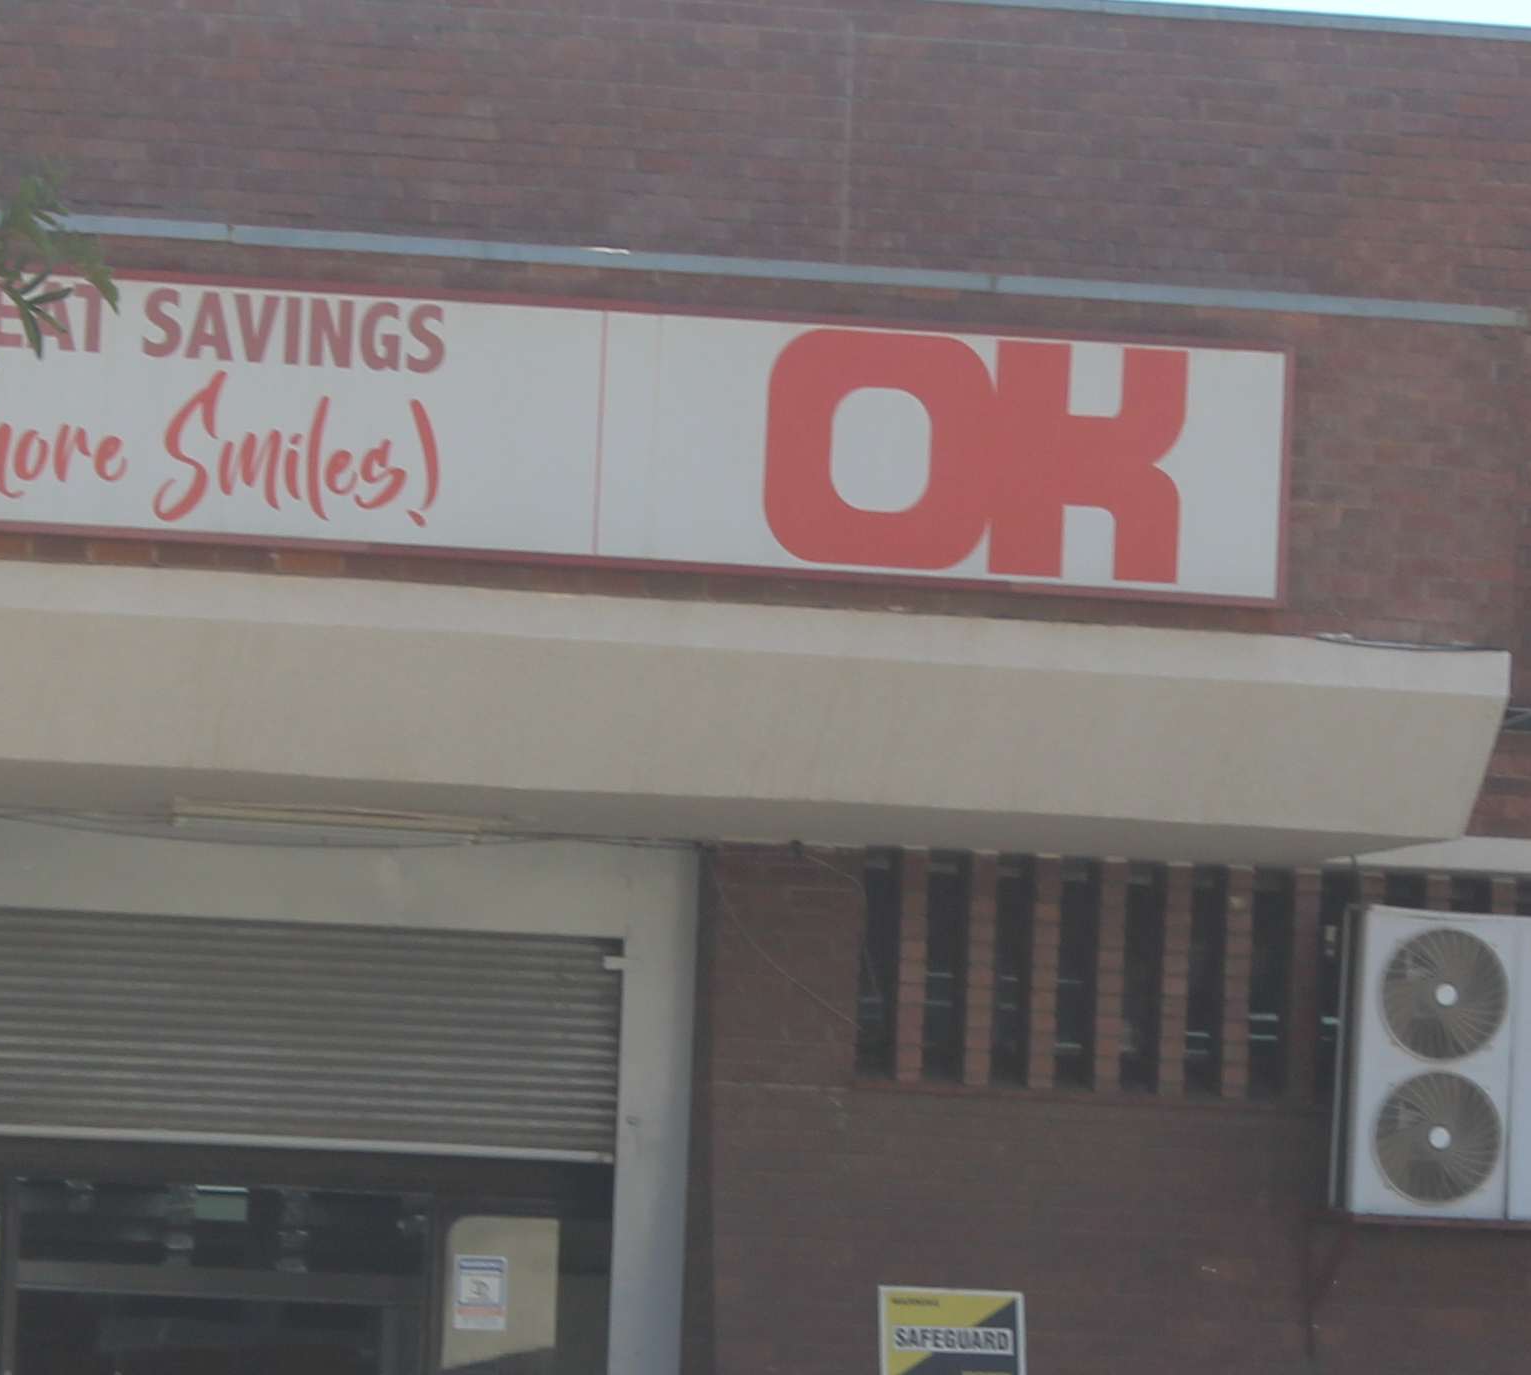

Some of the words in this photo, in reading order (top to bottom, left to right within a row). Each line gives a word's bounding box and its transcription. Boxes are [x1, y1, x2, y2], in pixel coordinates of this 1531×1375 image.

[141, 287, 446, 375] SAVINGS
[762, 327, 1190, 585] OK
[894, 1326, 1010, 1351] SAFEGUARD
